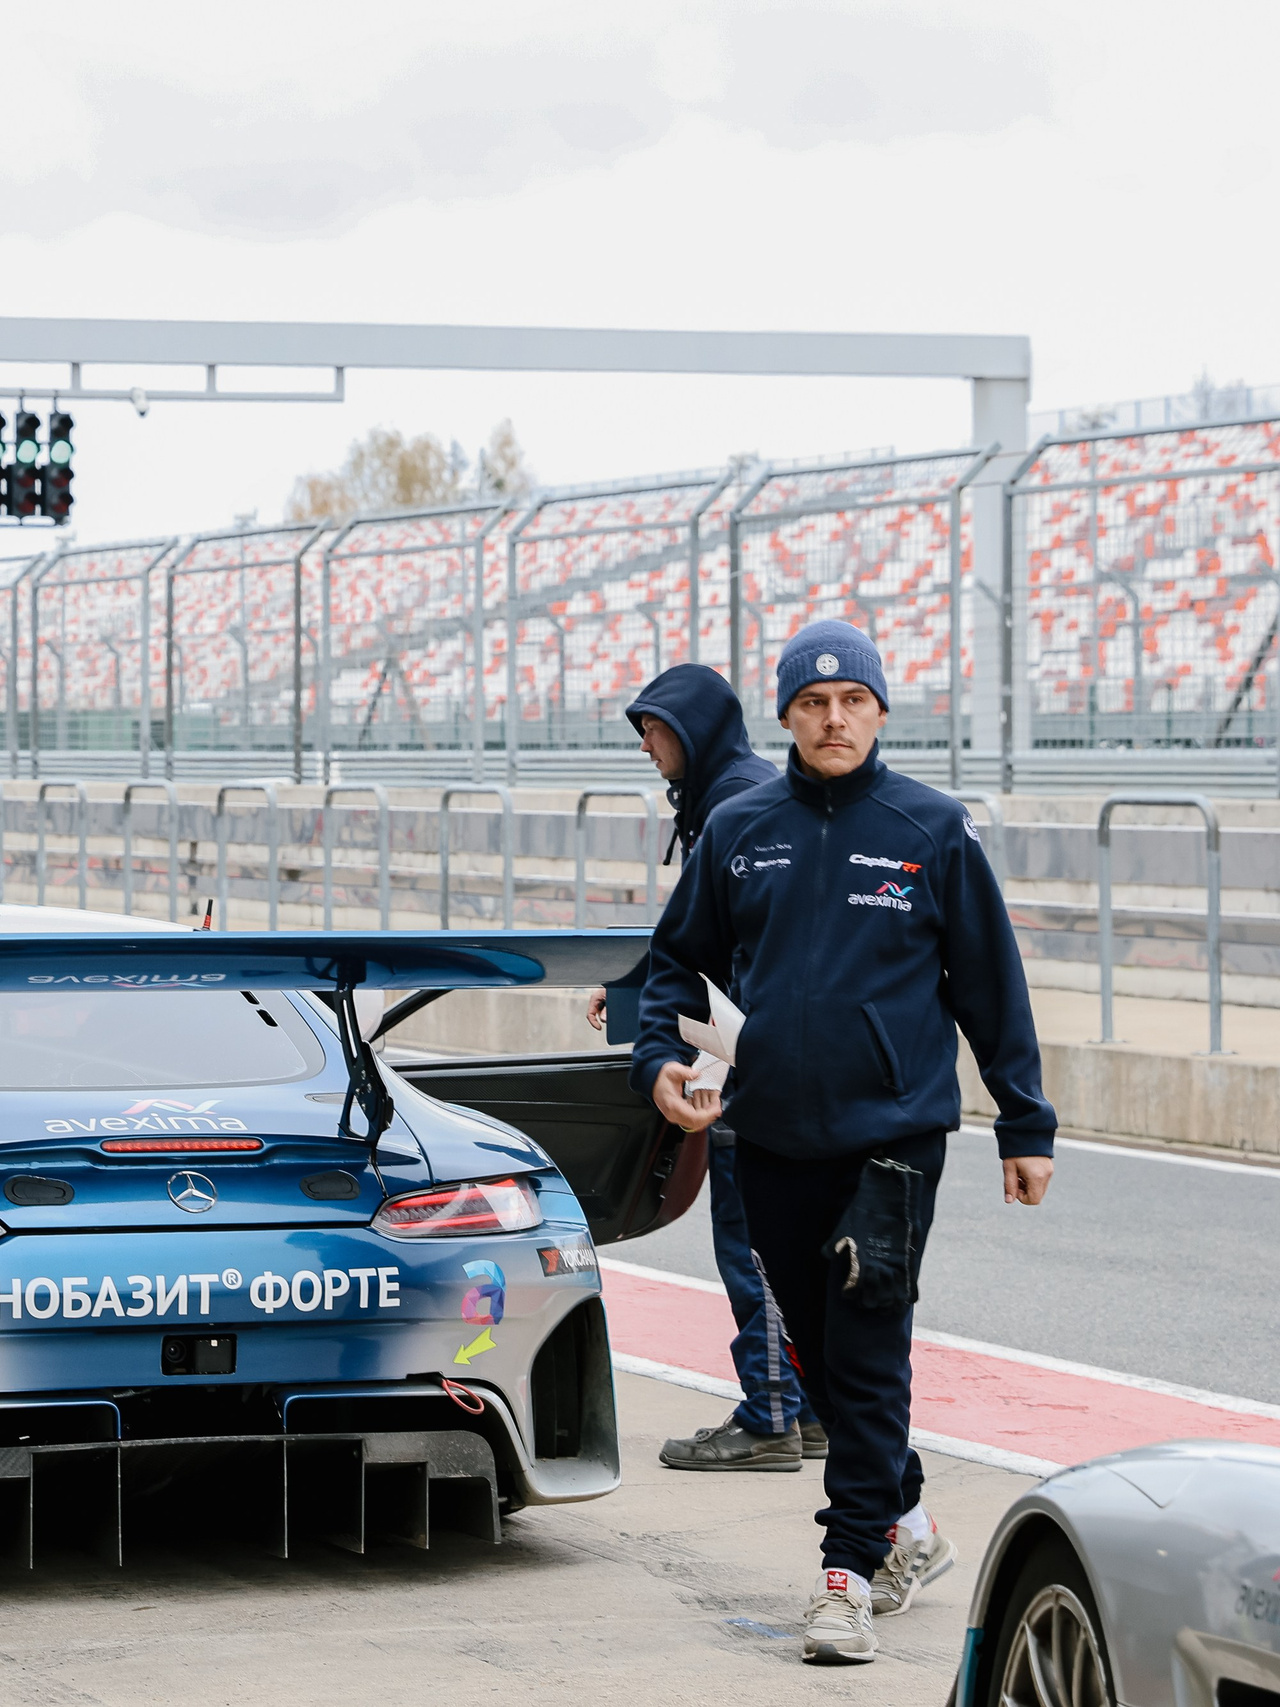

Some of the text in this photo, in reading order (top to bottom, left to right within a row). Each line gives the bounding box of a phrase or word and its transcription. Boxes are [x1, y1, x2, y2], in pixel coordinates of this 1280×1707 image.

[847, 892, 913, 912] avexima
[43, 1112, 249, 1134] avexima
[249, 1266, 401, 1315] ФОРТЕ
